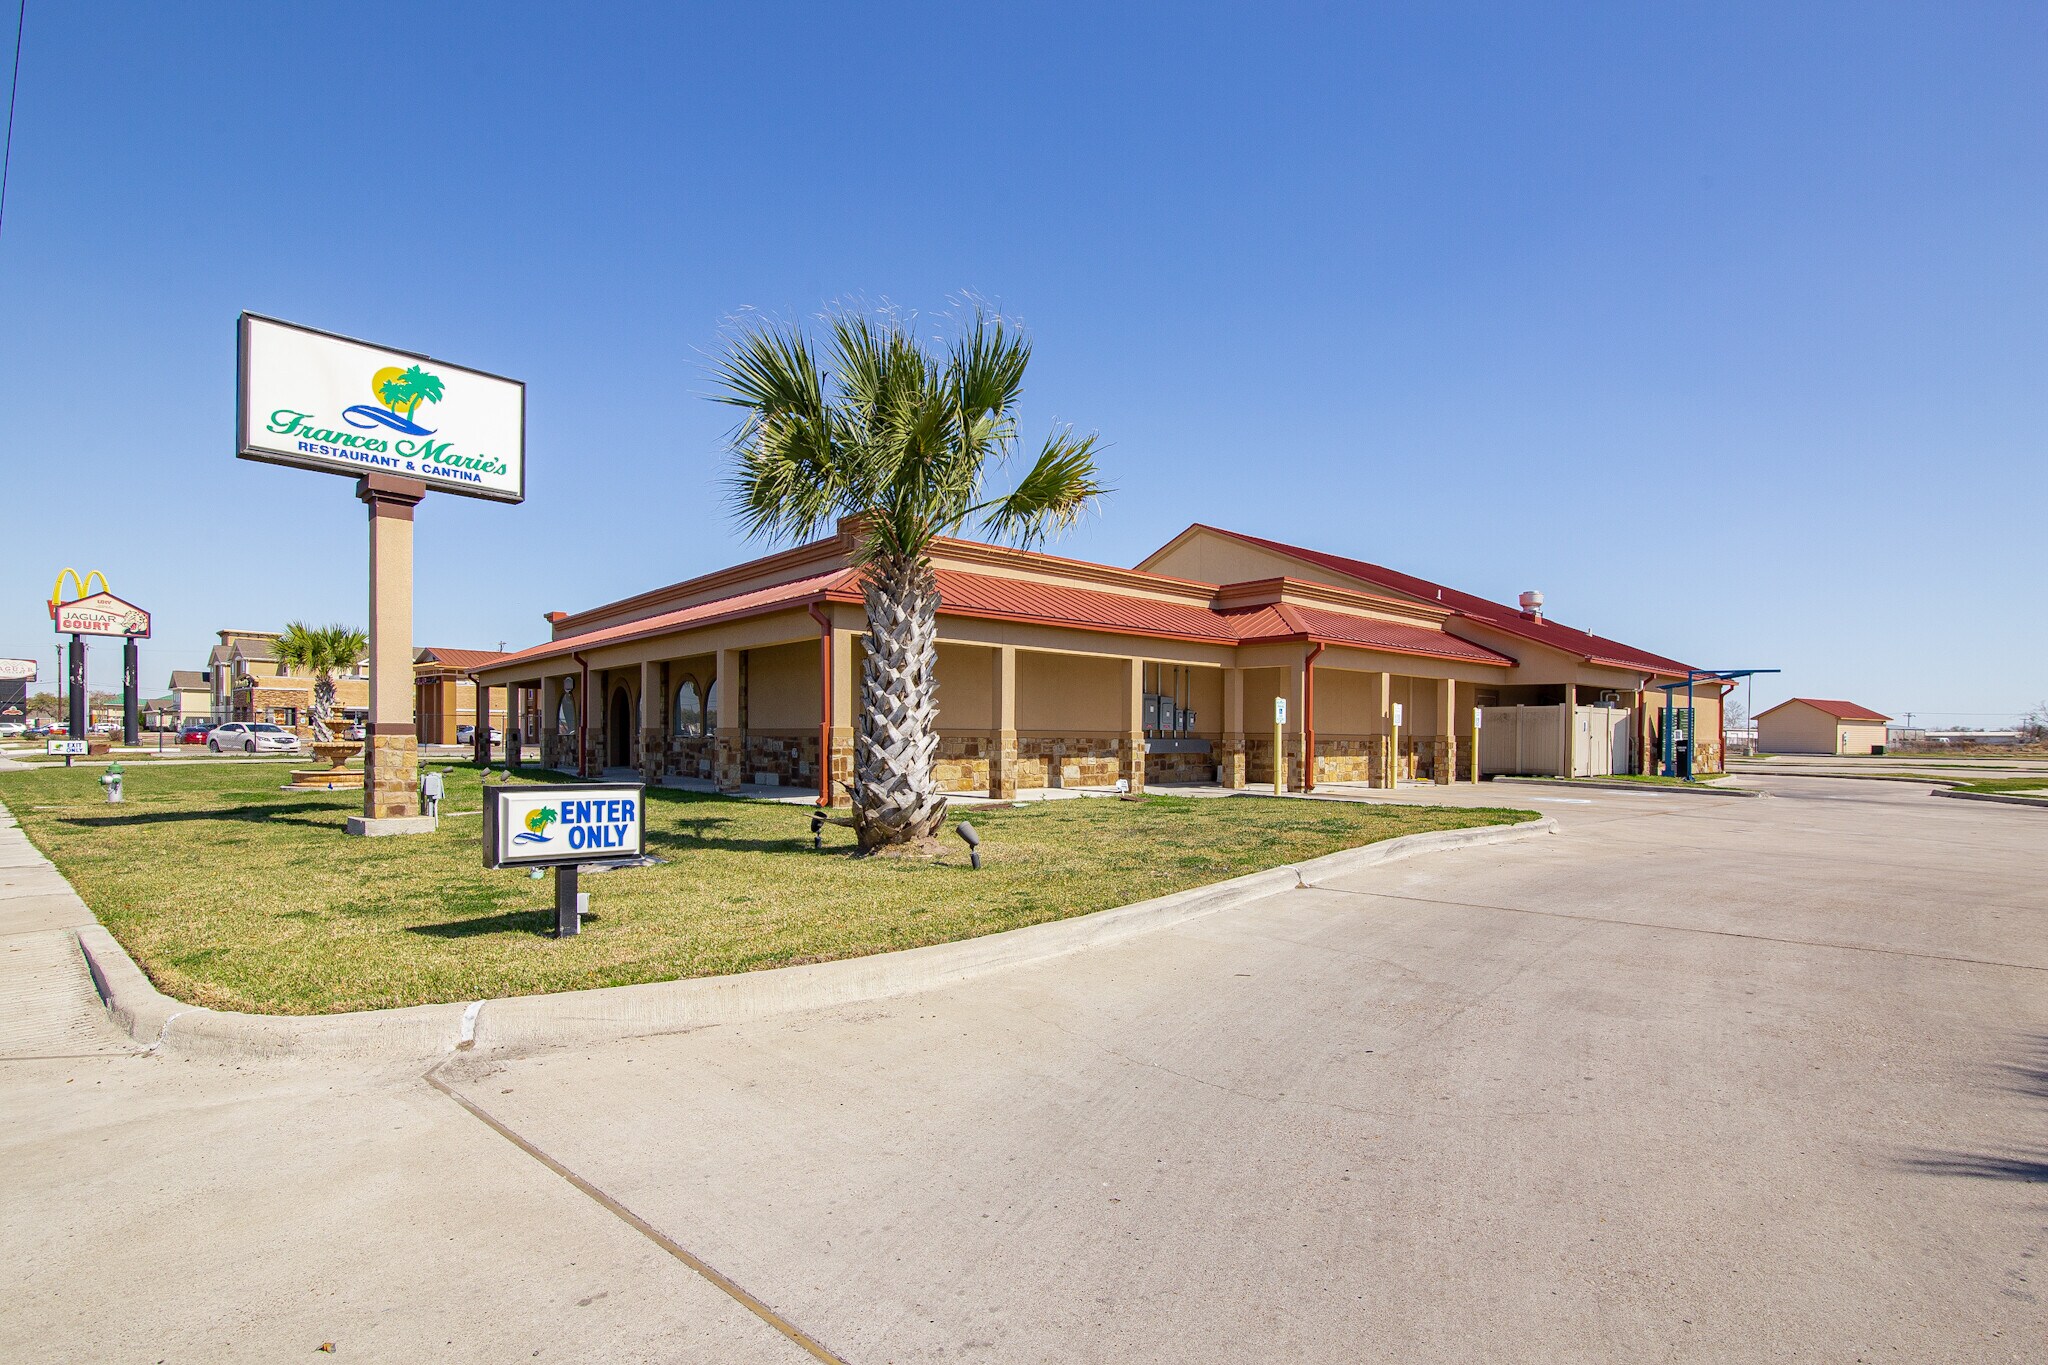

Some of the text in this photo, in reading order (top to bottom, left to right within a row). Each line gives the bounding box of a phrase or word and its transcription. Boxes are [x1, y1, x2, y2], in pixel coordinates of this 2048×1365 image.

[266, 409, 507, 476] Frances Marie's
[298, 441, 482, 483] RESTAURANT & CANTINA
[63, 612, 117, 623] JAGUAR
[63, 620, 110, 631] COURT
[561, 799, 635, 824] ENTER
[569, 823, 629, 850] ONLY
